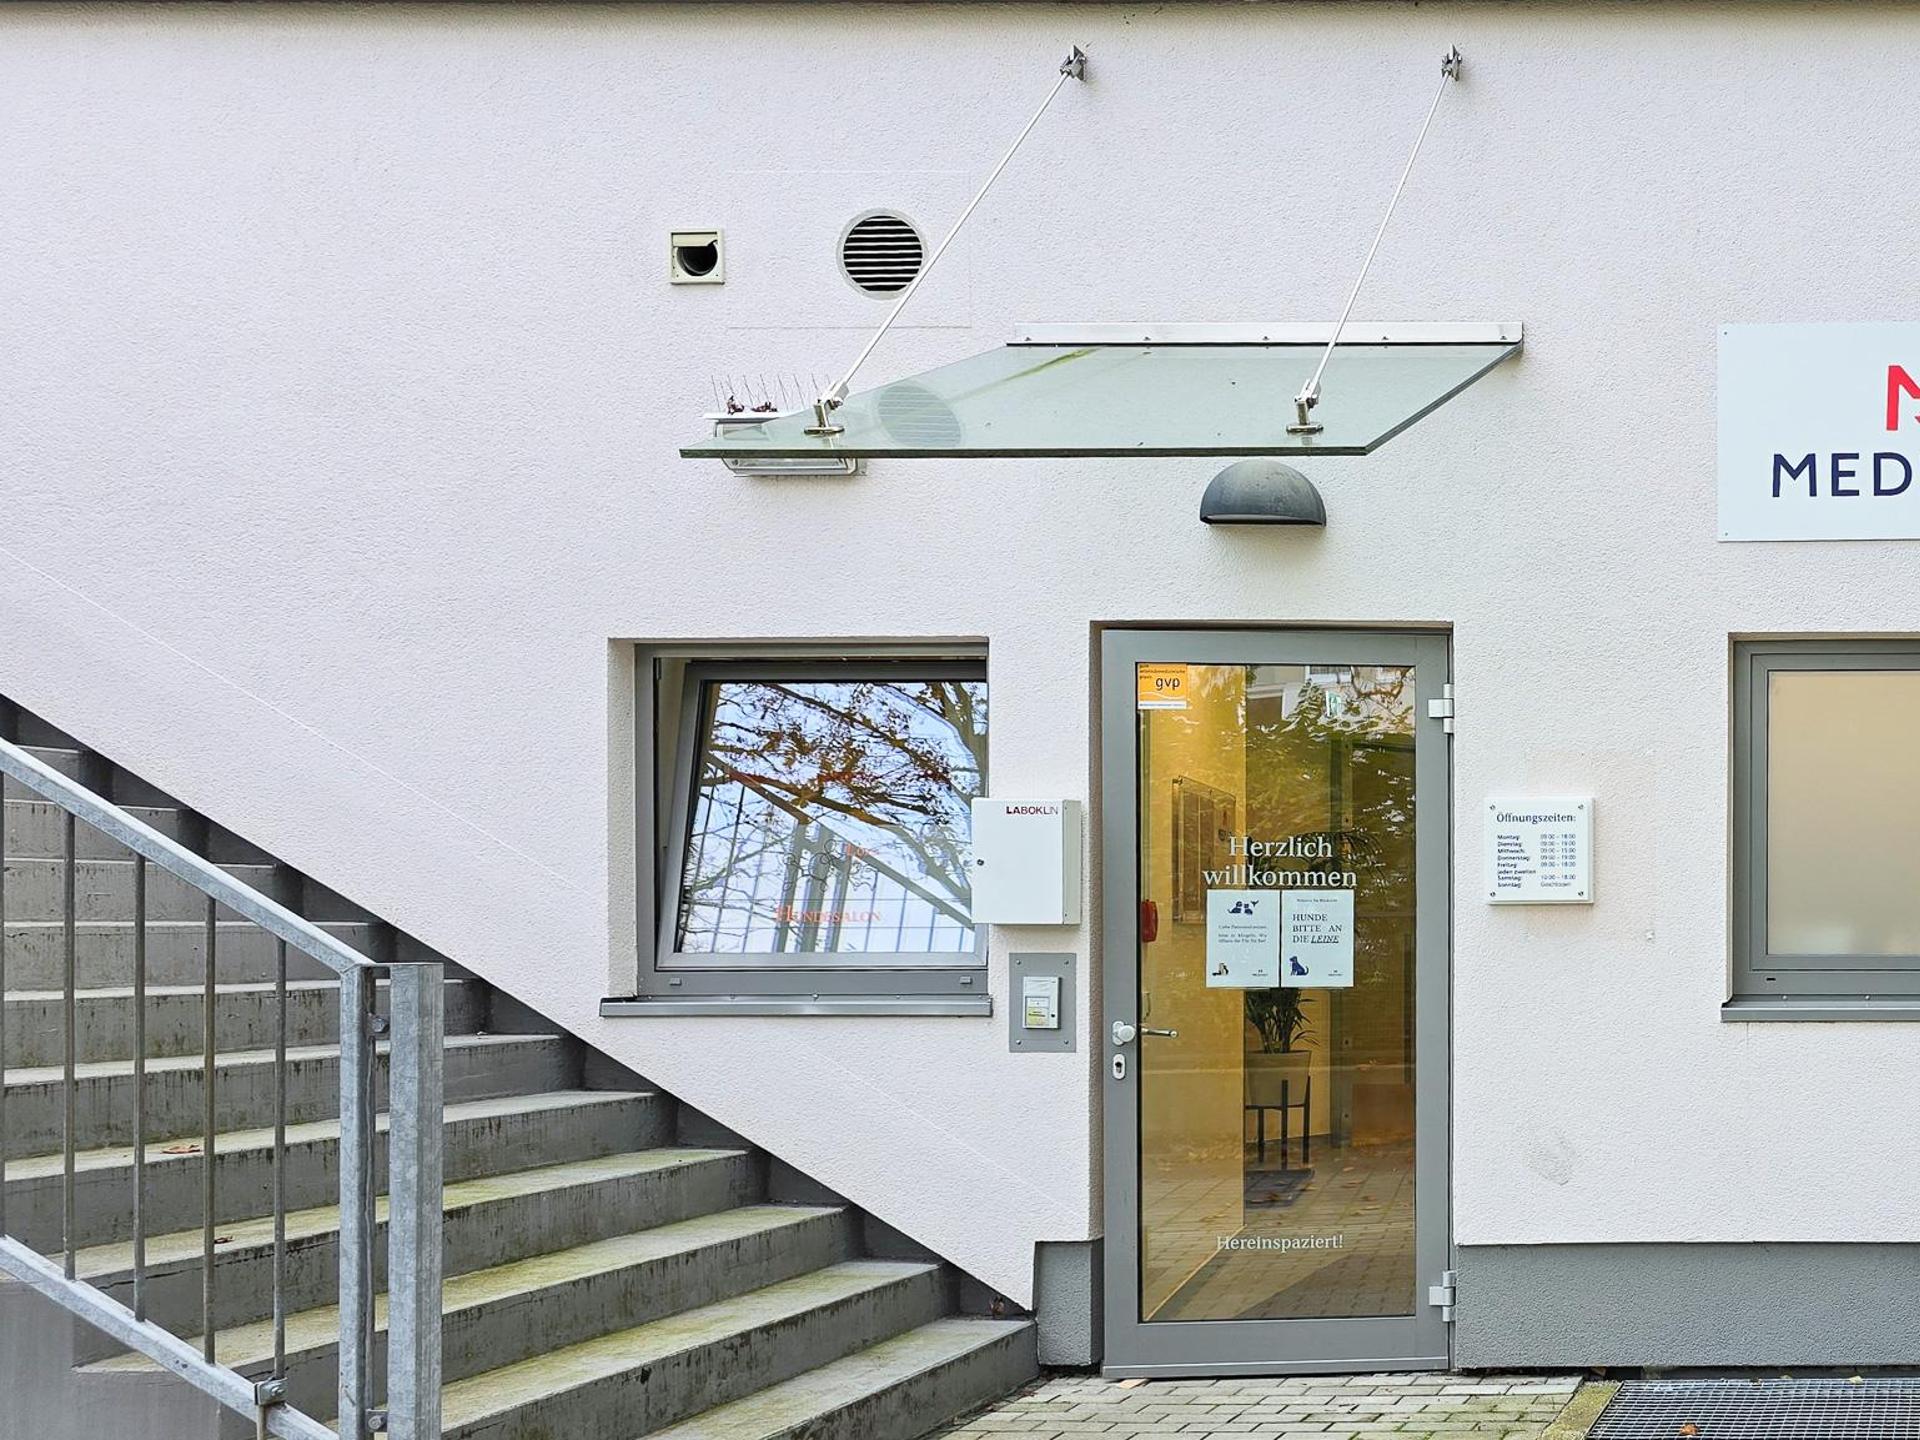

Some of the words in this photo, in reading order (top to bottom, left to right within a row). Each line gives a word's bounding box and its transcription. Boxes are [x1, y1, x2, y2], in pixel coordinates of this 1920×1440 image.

[1155, 677, 1181, 691] gvp
[1496, 812, 1576, 825] Öffnungszeiten:
[1229, 836, 1333, 858] Herzlich
[1202, 864, 1358, 887] willkommen
[1292, 913, 1328, 922] HUNDE
[1292, 924, 1321, 933] BITTE
[1328, 924, 1343, 933] AN
[1292, 934, 1310, 944] DIE
[1311, 934, 1340, 944] LEINE
[1216, 1234, 1344, 1253] Hereinspaziert!
